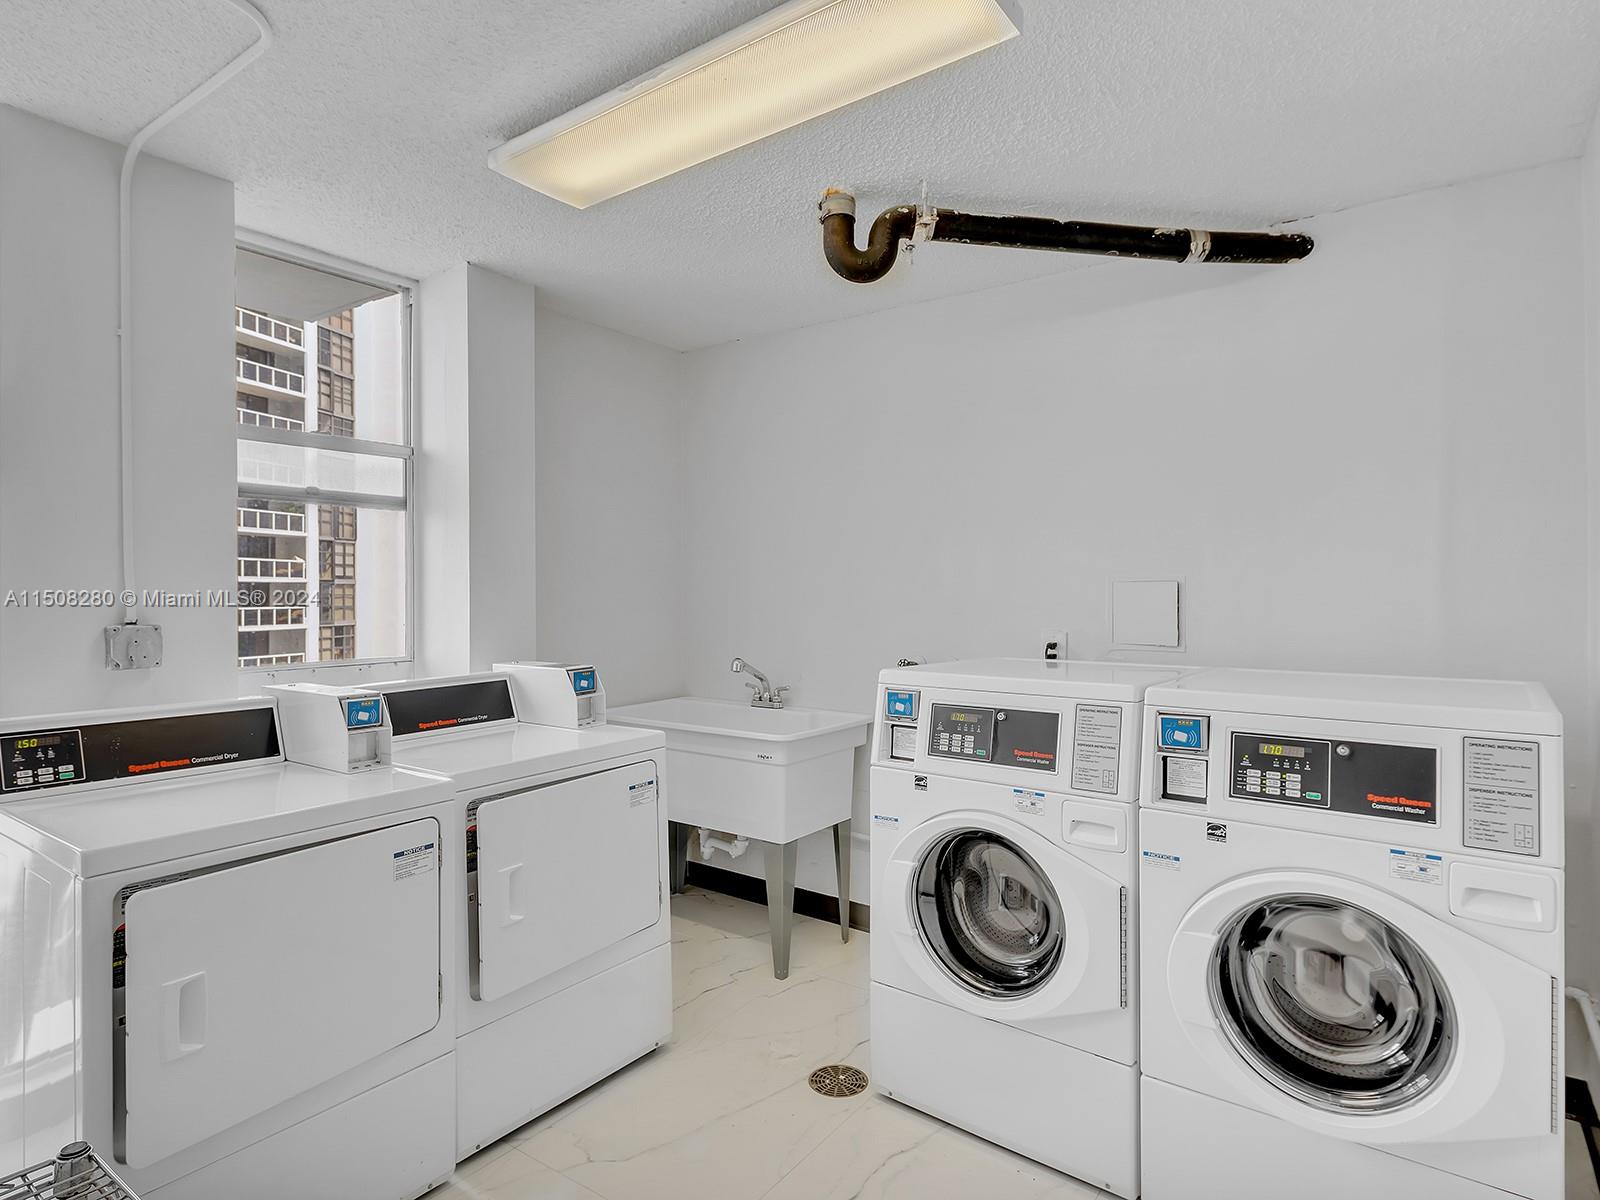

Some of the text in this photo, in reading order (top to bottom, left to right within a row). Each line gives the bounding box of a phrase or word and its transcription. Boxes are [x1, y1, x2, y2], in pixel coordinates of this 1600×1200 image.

[128, 752, 240, 773] Speed Queen Commercial Dryer
[1367, 793, 1432, 808] Speed Queen
[1497, 790, 1534, 798] INSTRUCTIONS
[1371, 802, 1426, 815] Commercial Washer
[1149, 851, 1173, 861] NOTICE
